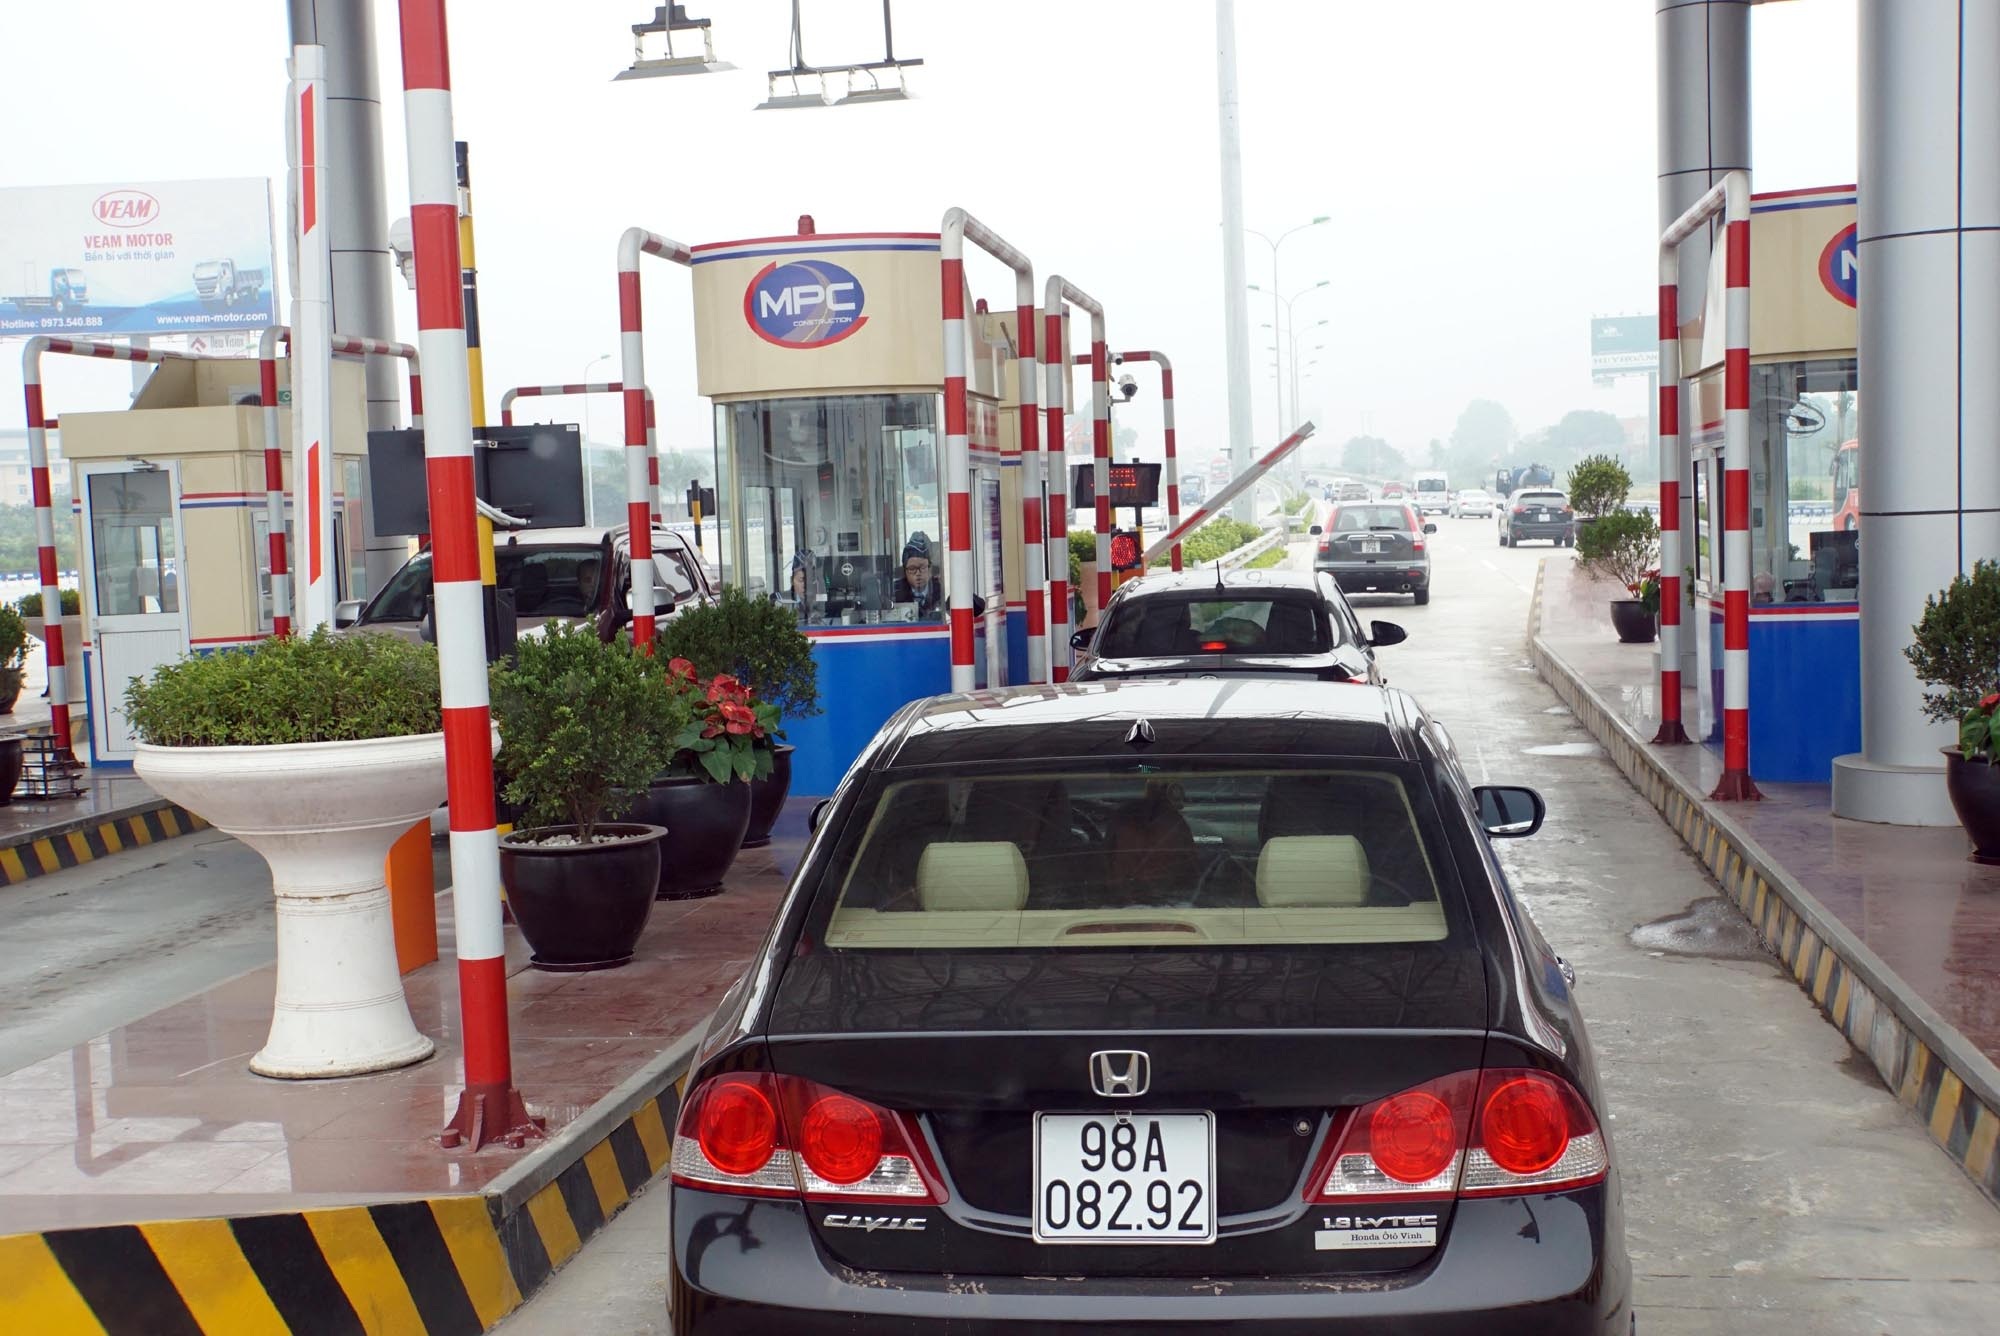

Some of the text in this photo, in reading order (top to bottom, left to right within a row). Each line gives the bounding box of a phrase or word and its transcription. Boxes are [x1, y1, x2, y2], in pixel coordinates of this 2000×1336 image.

[98, 199, 152, 219] VEAM
[84, 233, 173, 249] VEAM MOTOR
[154, 248, 175, 262] gian
[760, 282, 856, 318] MPC
[1, 319, 39, 329] Hotline:
[156, 312, 268, 325] www.veam-motor.com
[793, 316, 852, 327] CONSTRUCTION
[1081, 1120, 1168, 1172] 98A
[1045, 1179, 1204, 1231] 082.92
[823, 1214, 928, 1232] CIVIC
[1323, 1217, 1351, 1229] 1.8
[1351, 1233, 1380, 1241] Honda
[1401, 1231, 1422, 1240] Vinh
